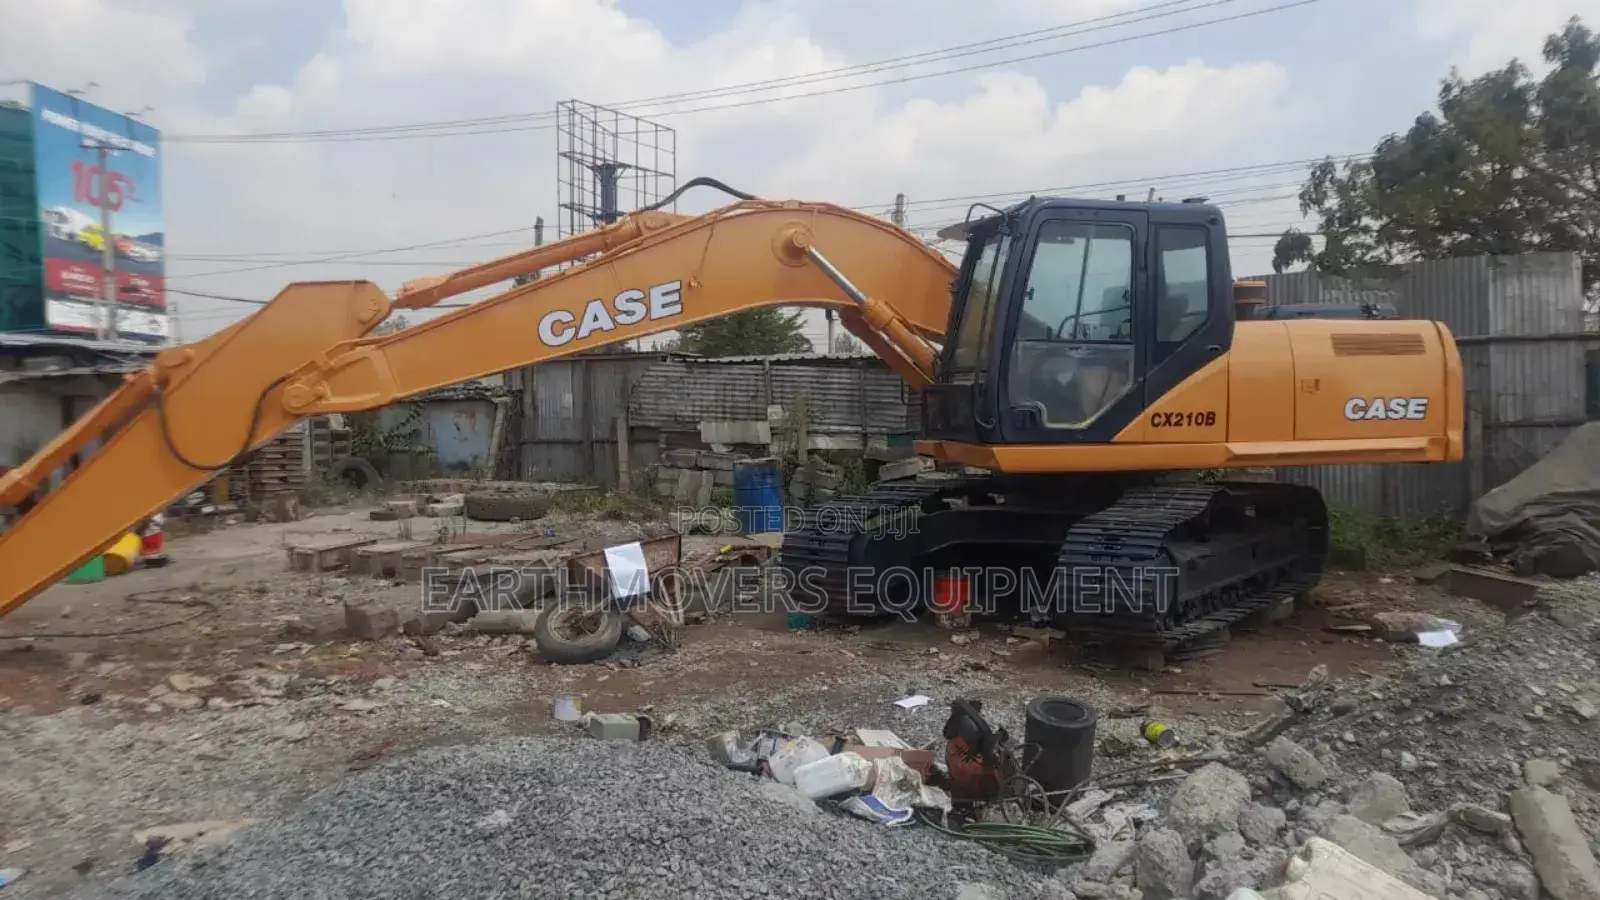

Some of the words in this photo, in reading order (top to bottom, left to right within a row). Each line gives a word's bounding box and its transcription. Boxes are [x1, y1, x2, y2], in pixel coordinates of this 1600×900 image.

[537, 280, 683, 347] CASE
[1151, 411, 1216, 428] CX210B
[1344, 397, 1428, 420] CASE
